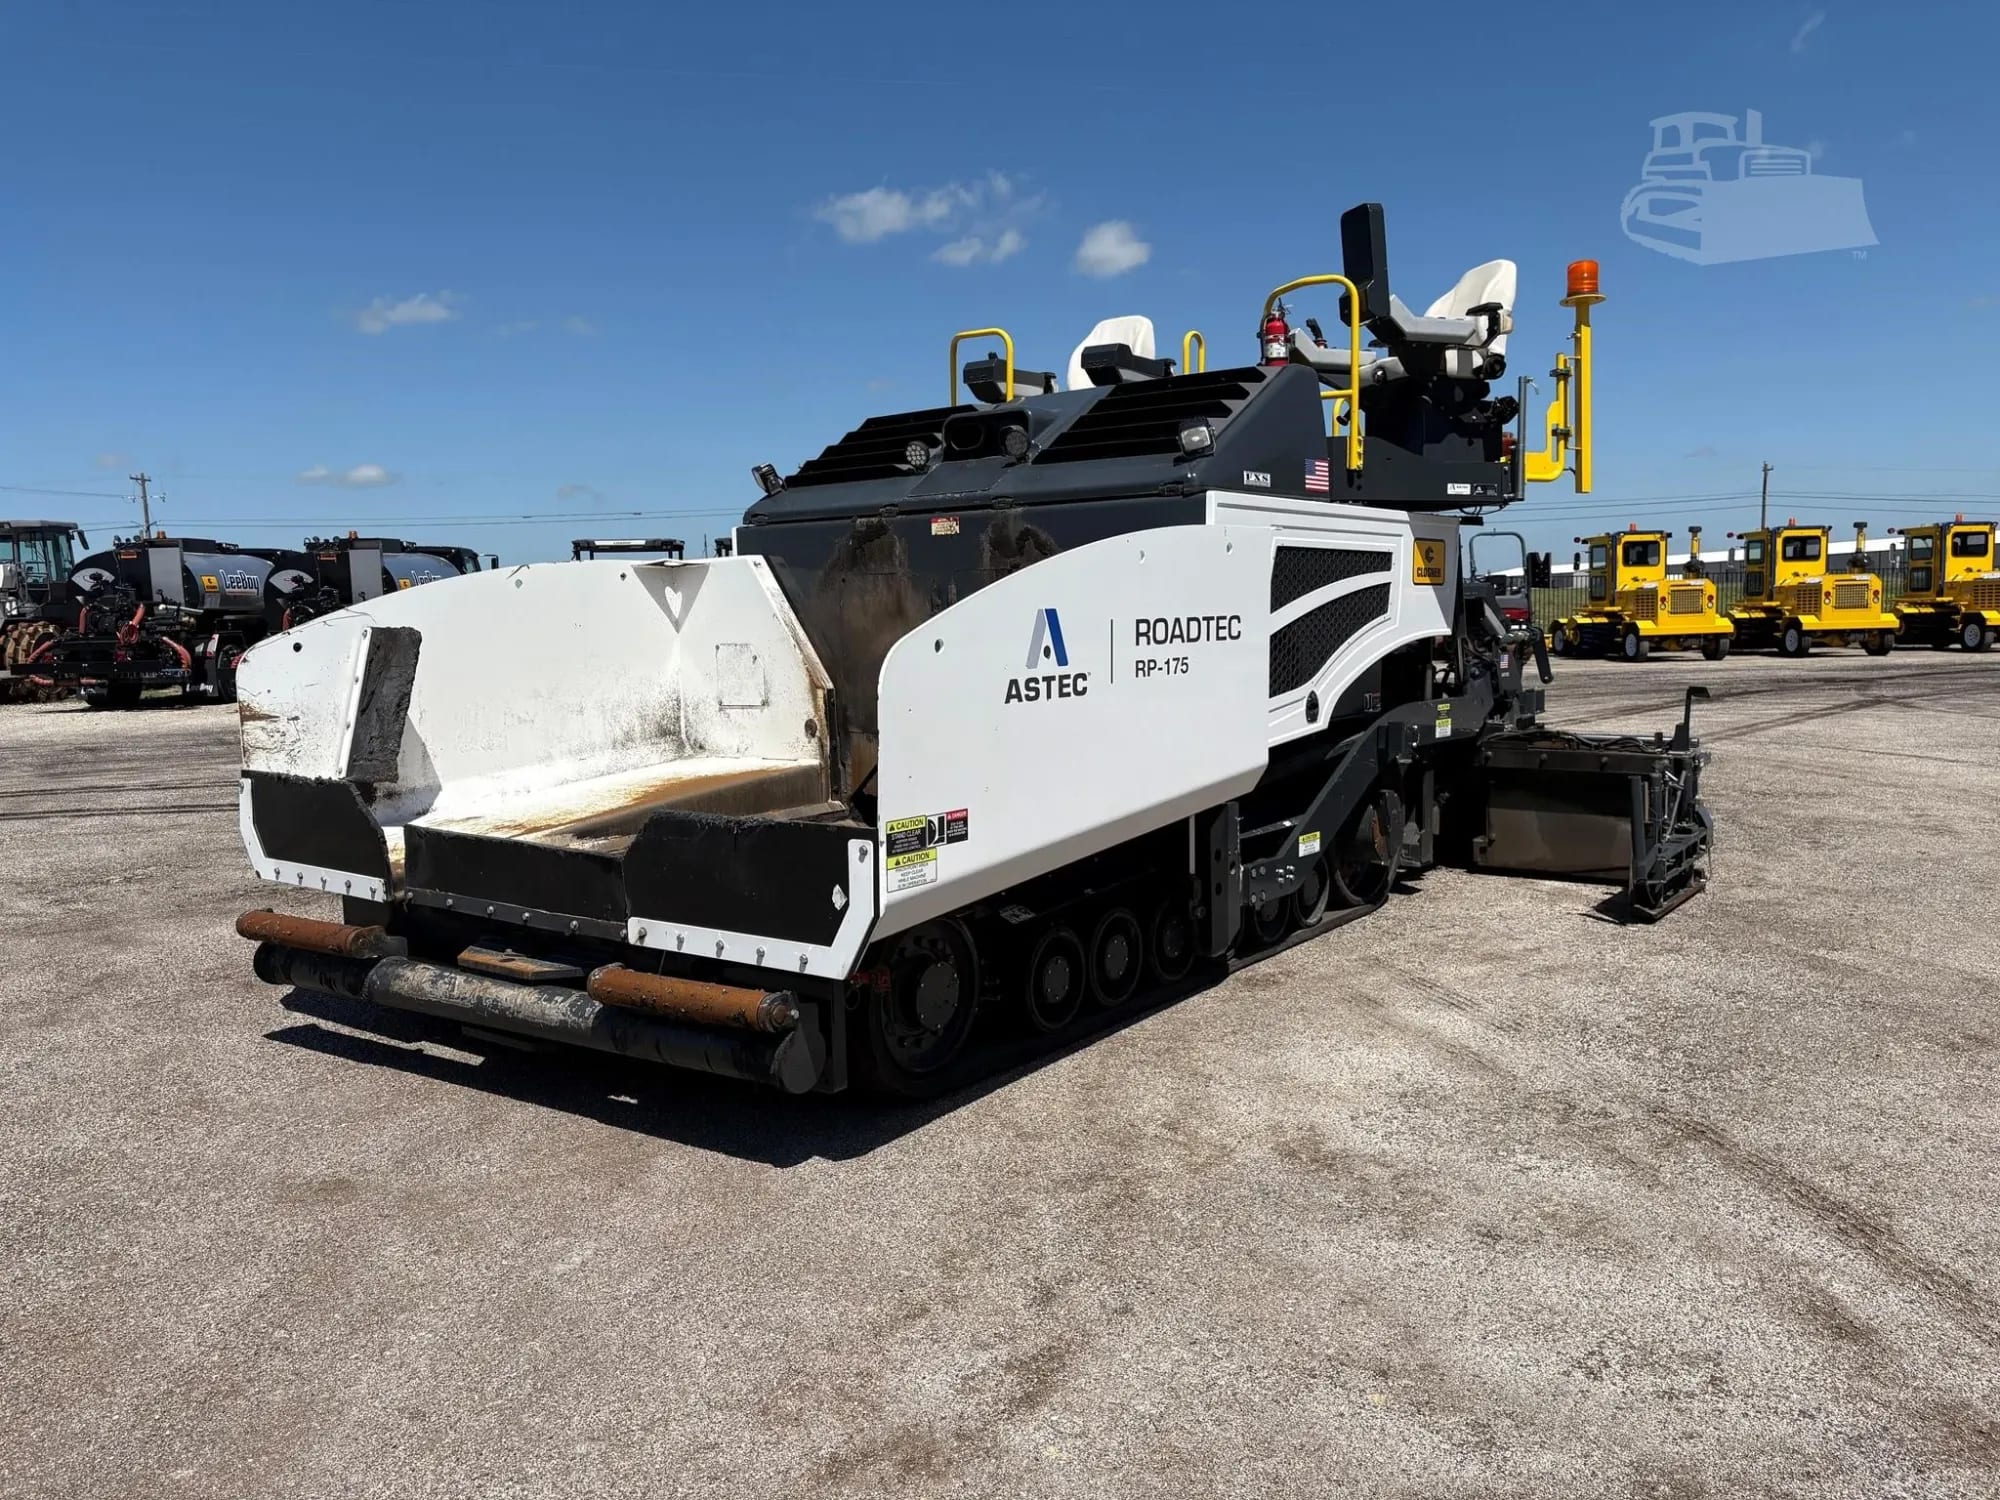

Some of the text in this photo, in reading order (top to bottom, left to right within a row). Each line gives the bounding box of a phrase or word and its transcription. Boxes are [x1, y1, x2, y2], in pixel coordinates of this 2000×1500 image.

[219, 569, 260, 595] LeeBoy
[1135, 615, 1241, 646] ROADTEC
[1135, 657, 1189, 678] RP-175
[1004, 672, 1089, 704] ASTEC
[896, 818, 924, 830] CAUTION
[906, 829, 921, 837] CLEAR
[901, 852, 930, 864] CAUTION
